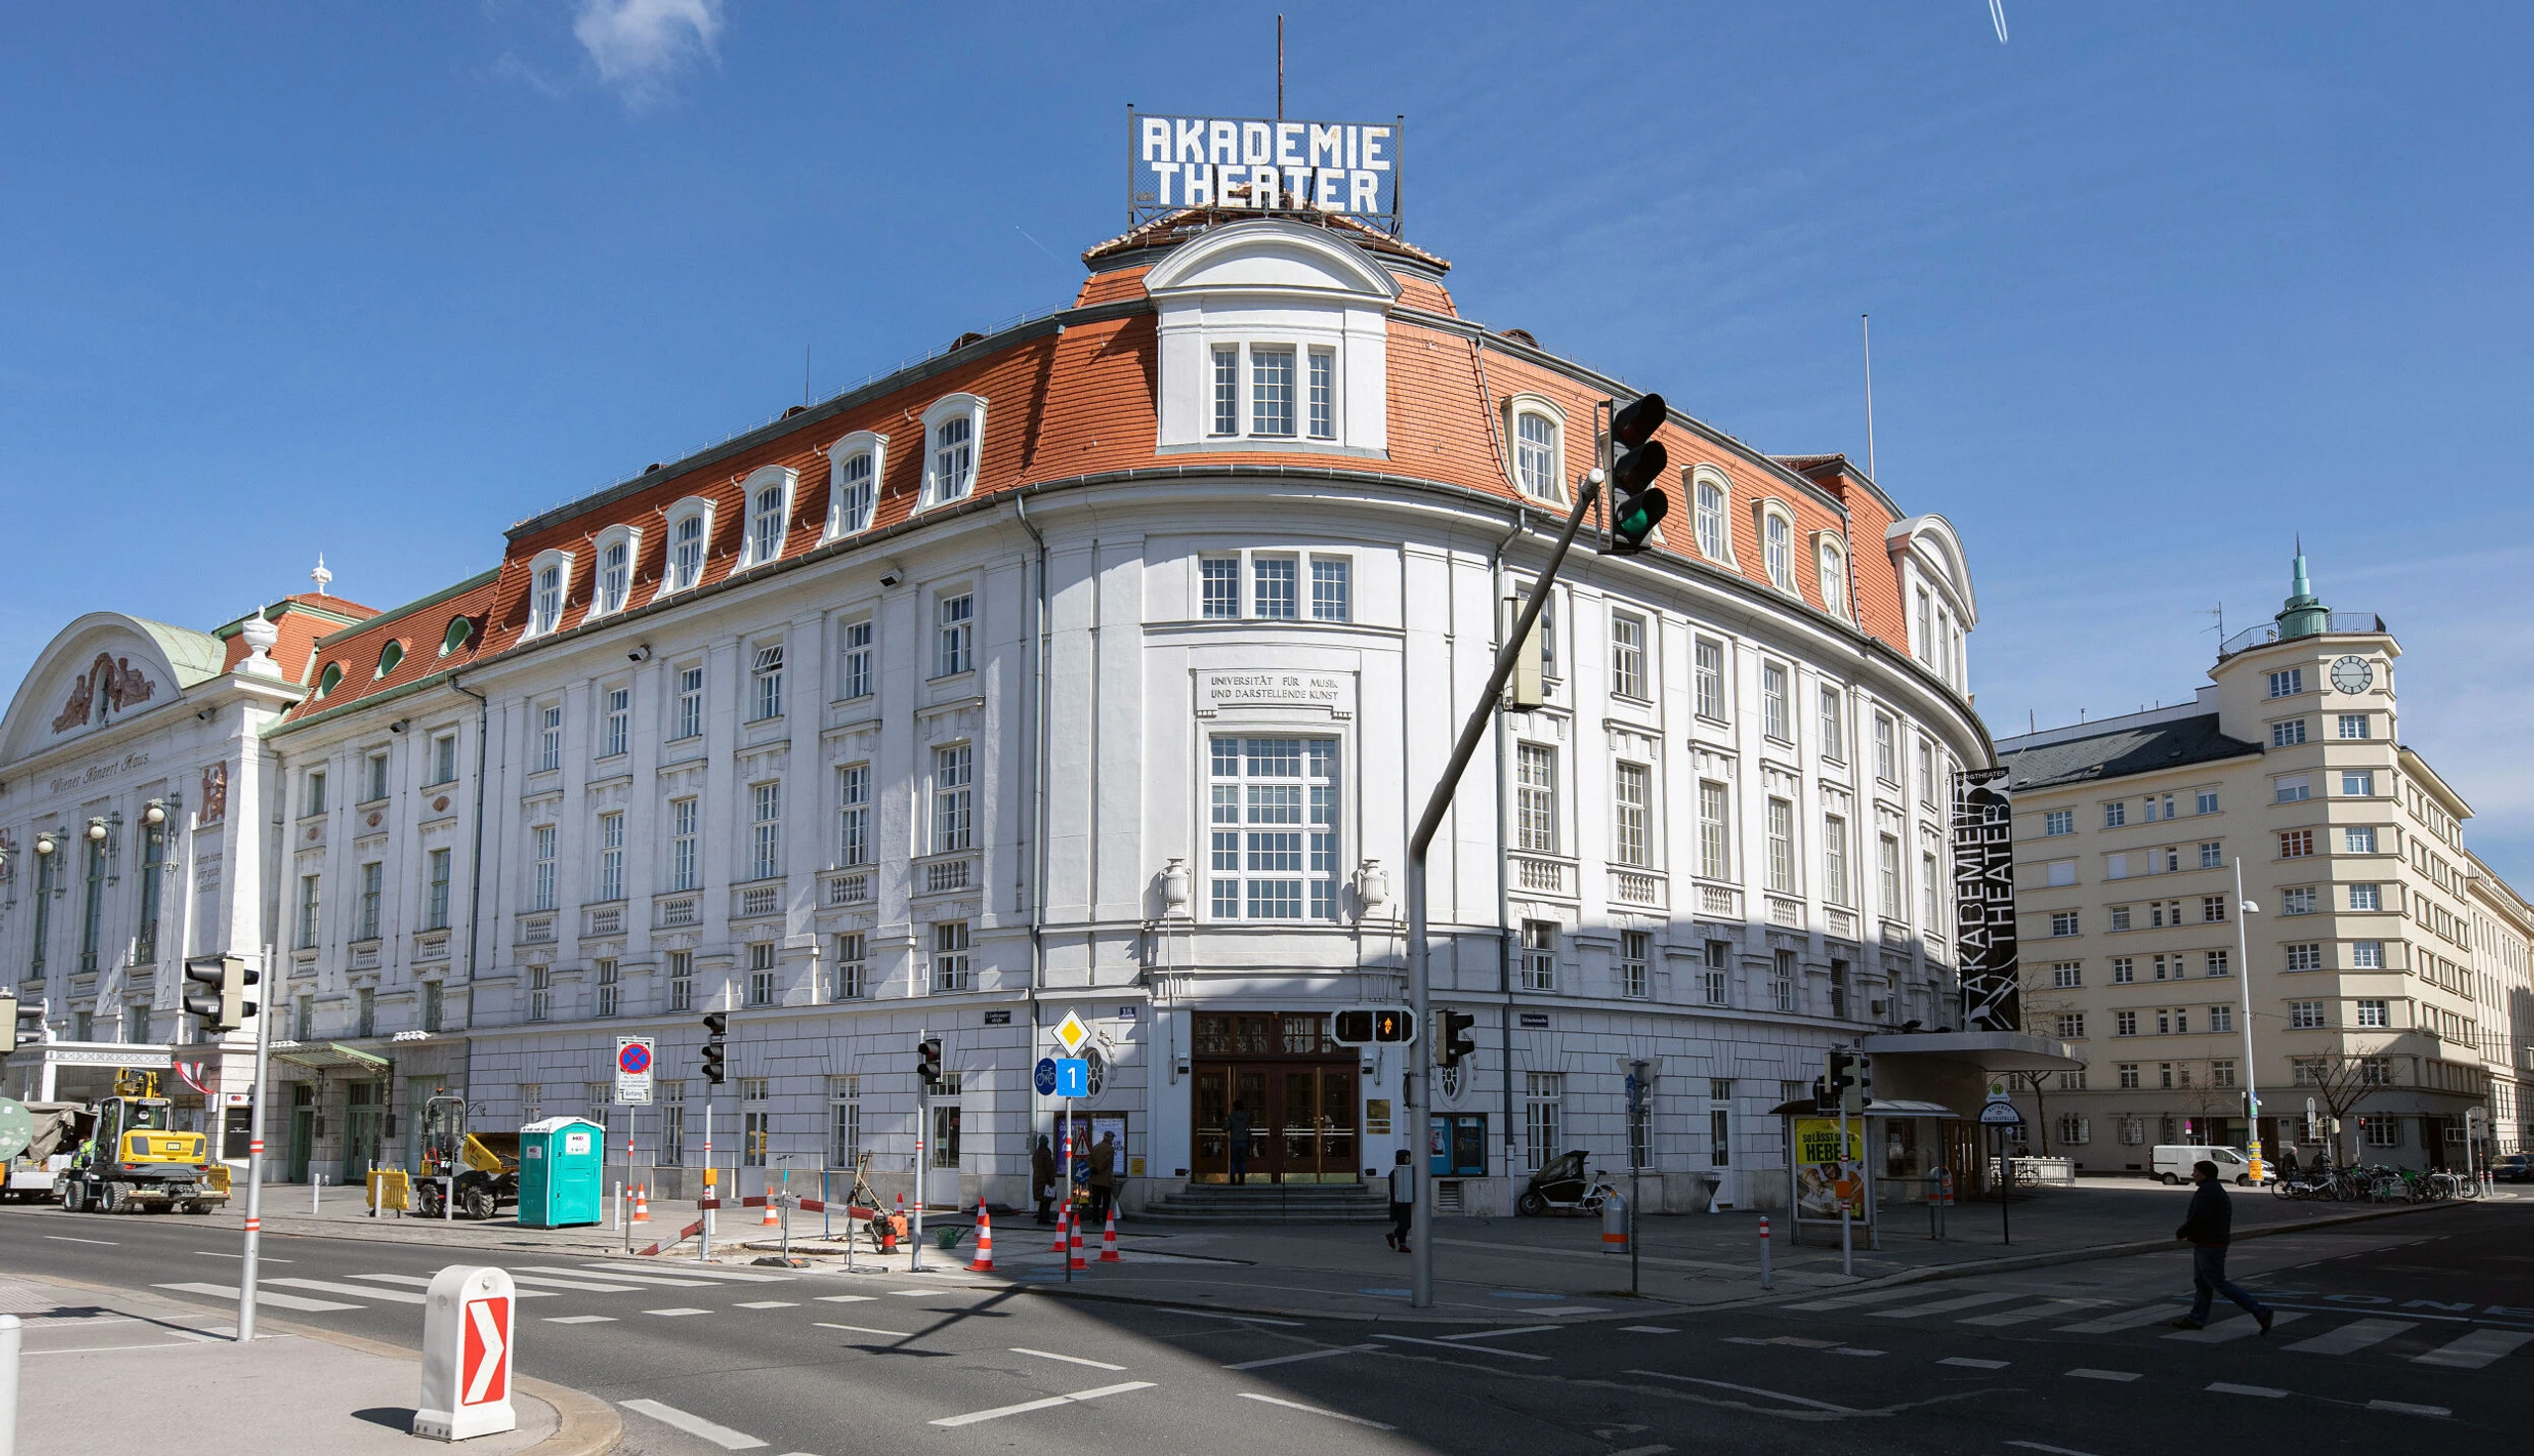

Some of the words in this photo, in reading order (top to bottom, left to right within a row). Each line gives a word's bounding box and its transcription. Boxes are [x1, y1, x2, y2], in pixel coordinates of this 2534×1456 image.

[1142, 117, 1390, 170] AKADEMIE
[1151, 161, 1378, 213] THEATER
[1211, 675, 1273, 686] UNIVERSITÄT
[1282, 676, 1300, 687] FÜR
[1310, 678, 1338, 689] MUSIK
[1211, 689, 1231, 699] UND
[1235, 689, 1307, 699] DARSTELLENDE
[1310, 690, 1338, 700] KUNST
[50, 775, 81, 795] Wiener
[1956, 770, 2006, 782] BURGTHEATER
[1983, 804, 2014, 948] THEATER
[1956, 827, 1988, 994] AKADEMIE
[1067, 1067, 1076, 1089] 1
[1803, 1133, 1811, 1142] SO
[1812, 1130, 1833, 1142] LÄSST
